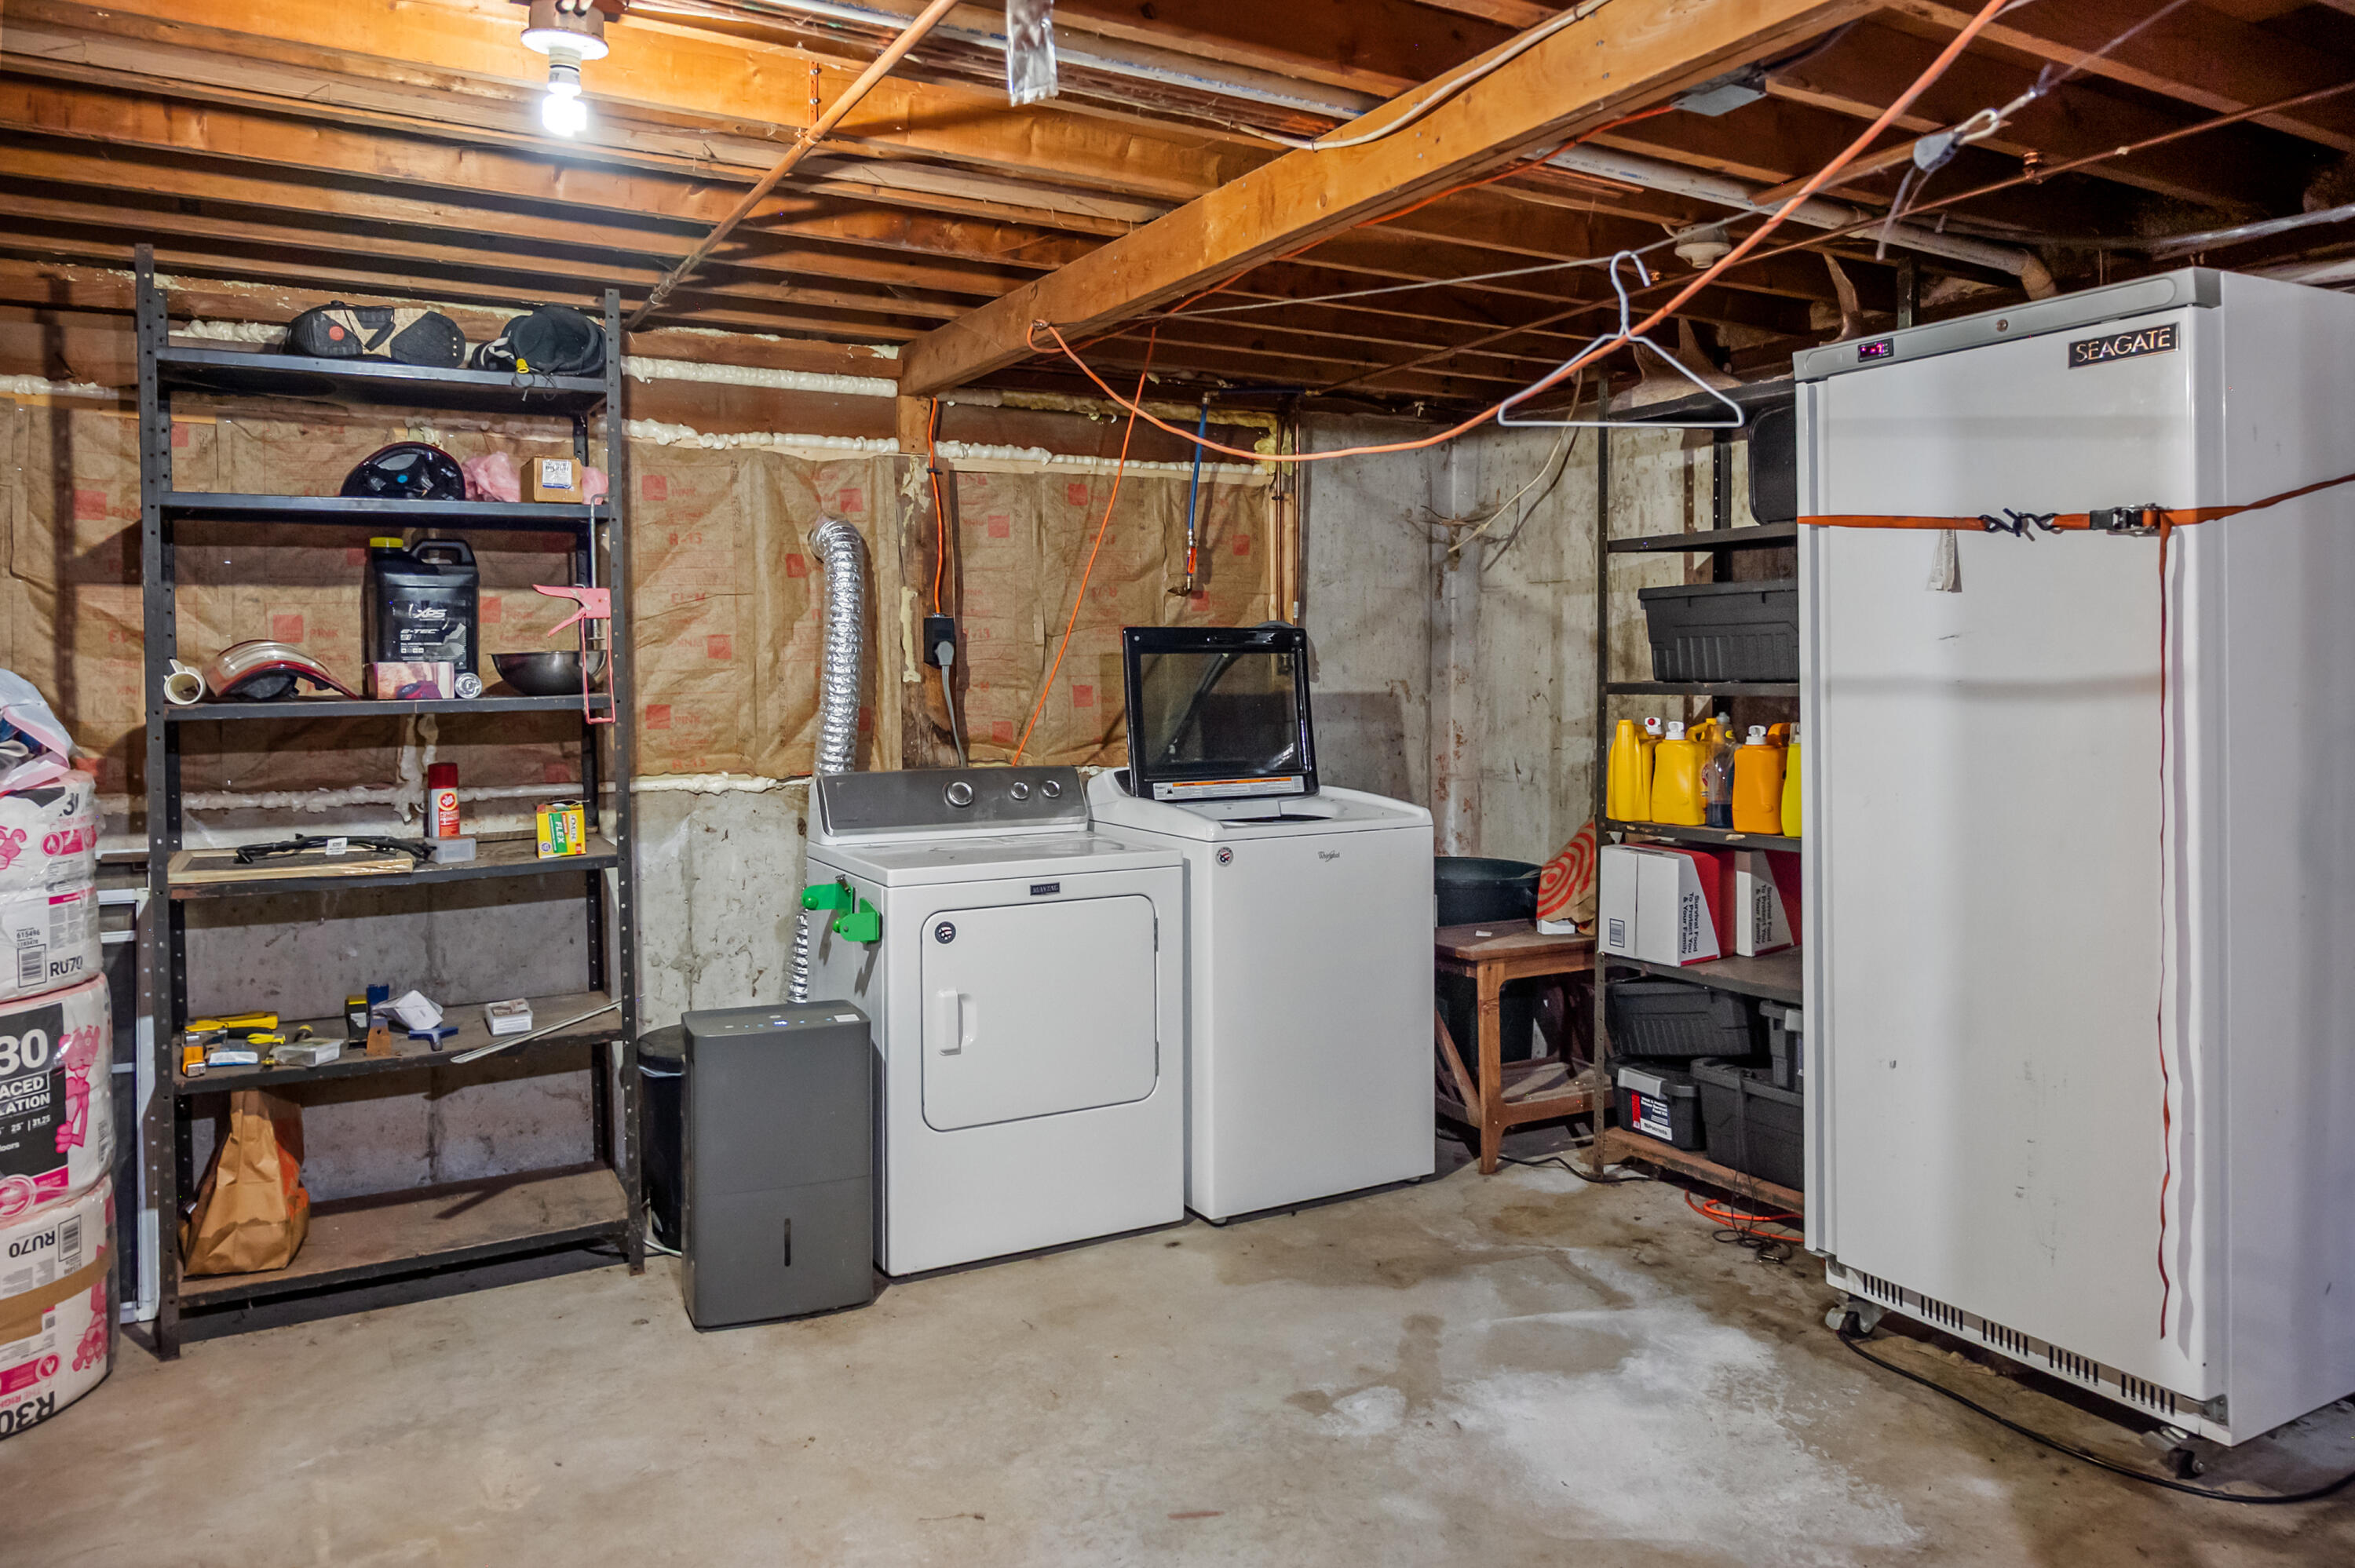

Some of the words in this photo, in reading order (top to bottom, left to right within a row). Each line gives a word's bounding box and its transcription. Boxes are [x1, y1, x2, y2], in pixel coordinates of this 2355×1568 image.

[2075, 327, 2171, 363] SEAGATE
[111, 506, 142, 519] PIN
[669, 532, 703, 546] R-13
[555, 821, 565, 844] FLEX
[1689, 892, 1694, 902] To
[1762, 884, 1766, 893] To
[49, 955, 83, 977] RU70
[0, 1029, 49, 1076] 30
[9, 1230, 55, 1258] RU70
[0, 1390, 55, 1435] R30
